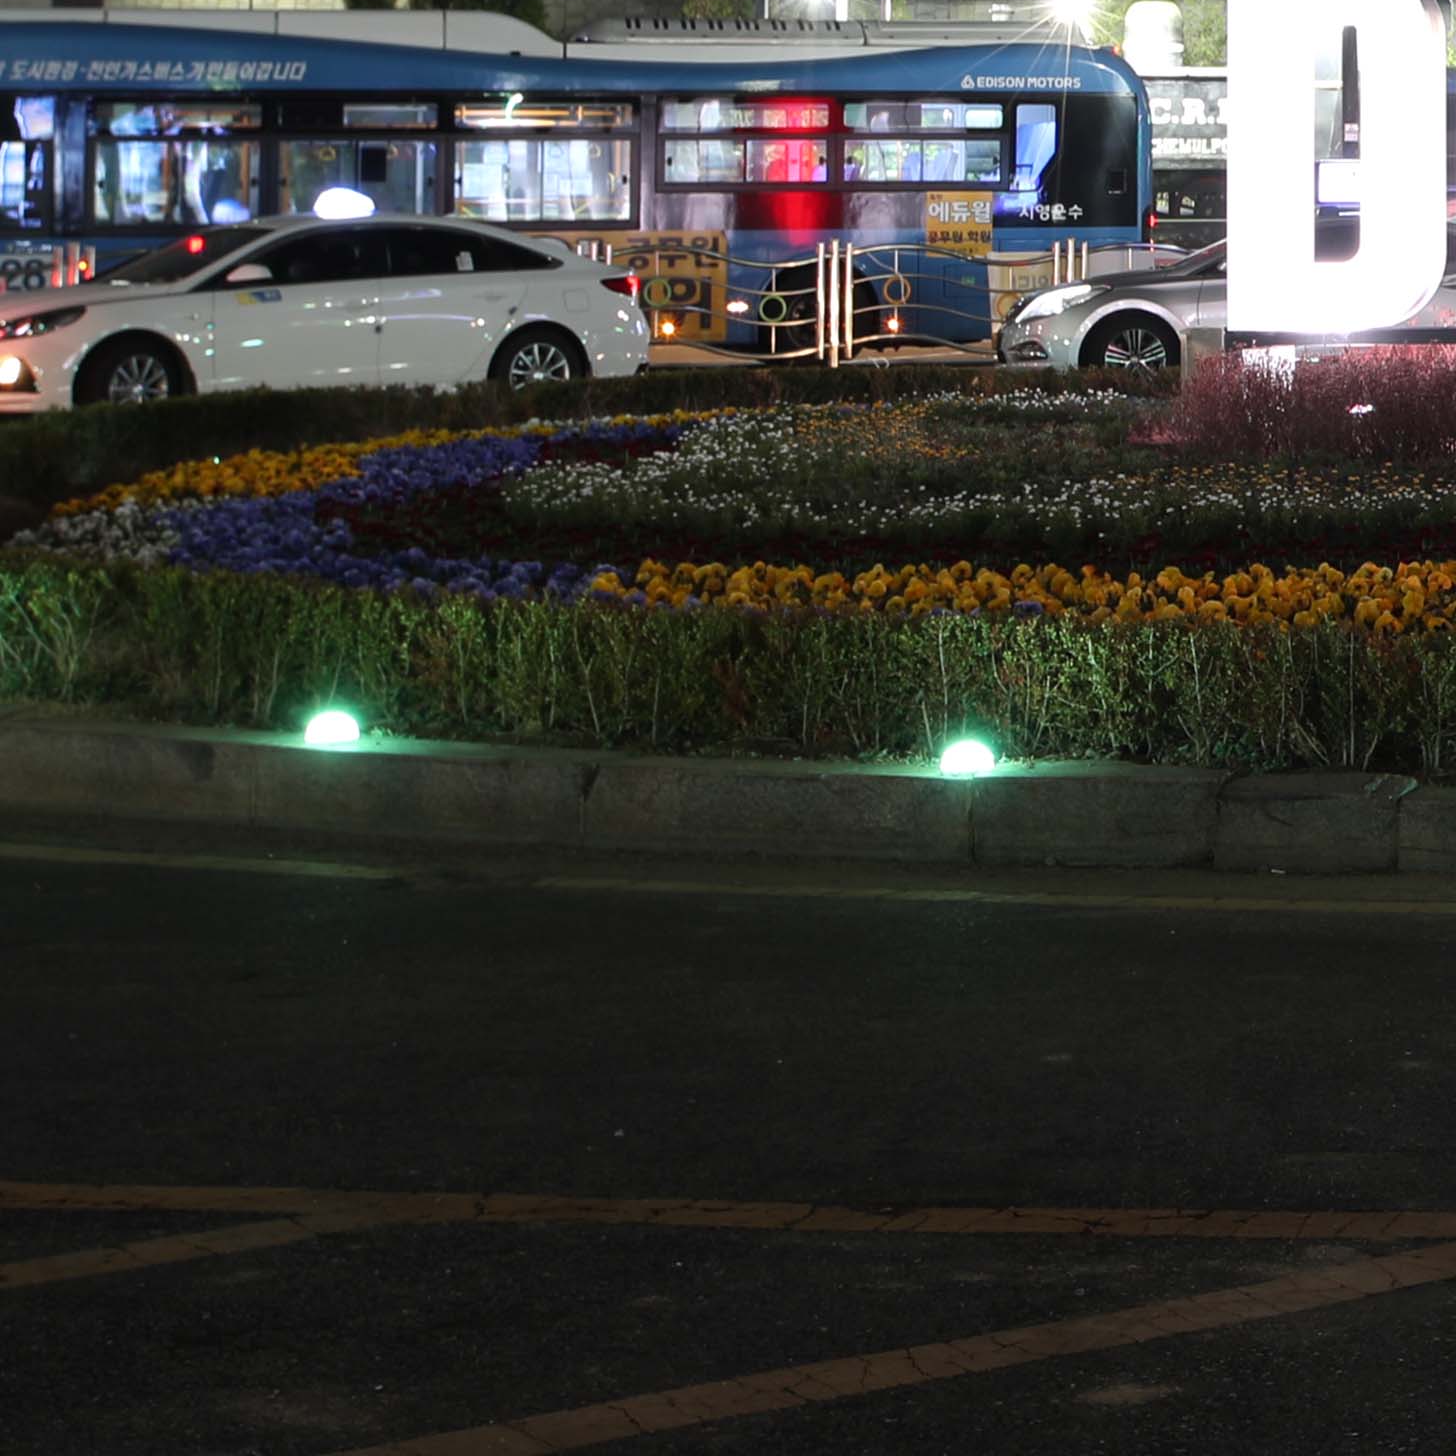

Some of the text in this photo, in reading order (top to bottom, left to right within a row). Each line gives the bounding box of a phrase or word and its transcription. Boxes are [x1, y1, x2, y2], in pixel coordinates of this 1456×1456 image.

[976, 76, 1081, 89] EDISON MOTORS
[928, 200, 991, 224] 에듀윌
[1018, 202, 1083, 223] 시영운수
[627, 235, 720, 269] 공무원
